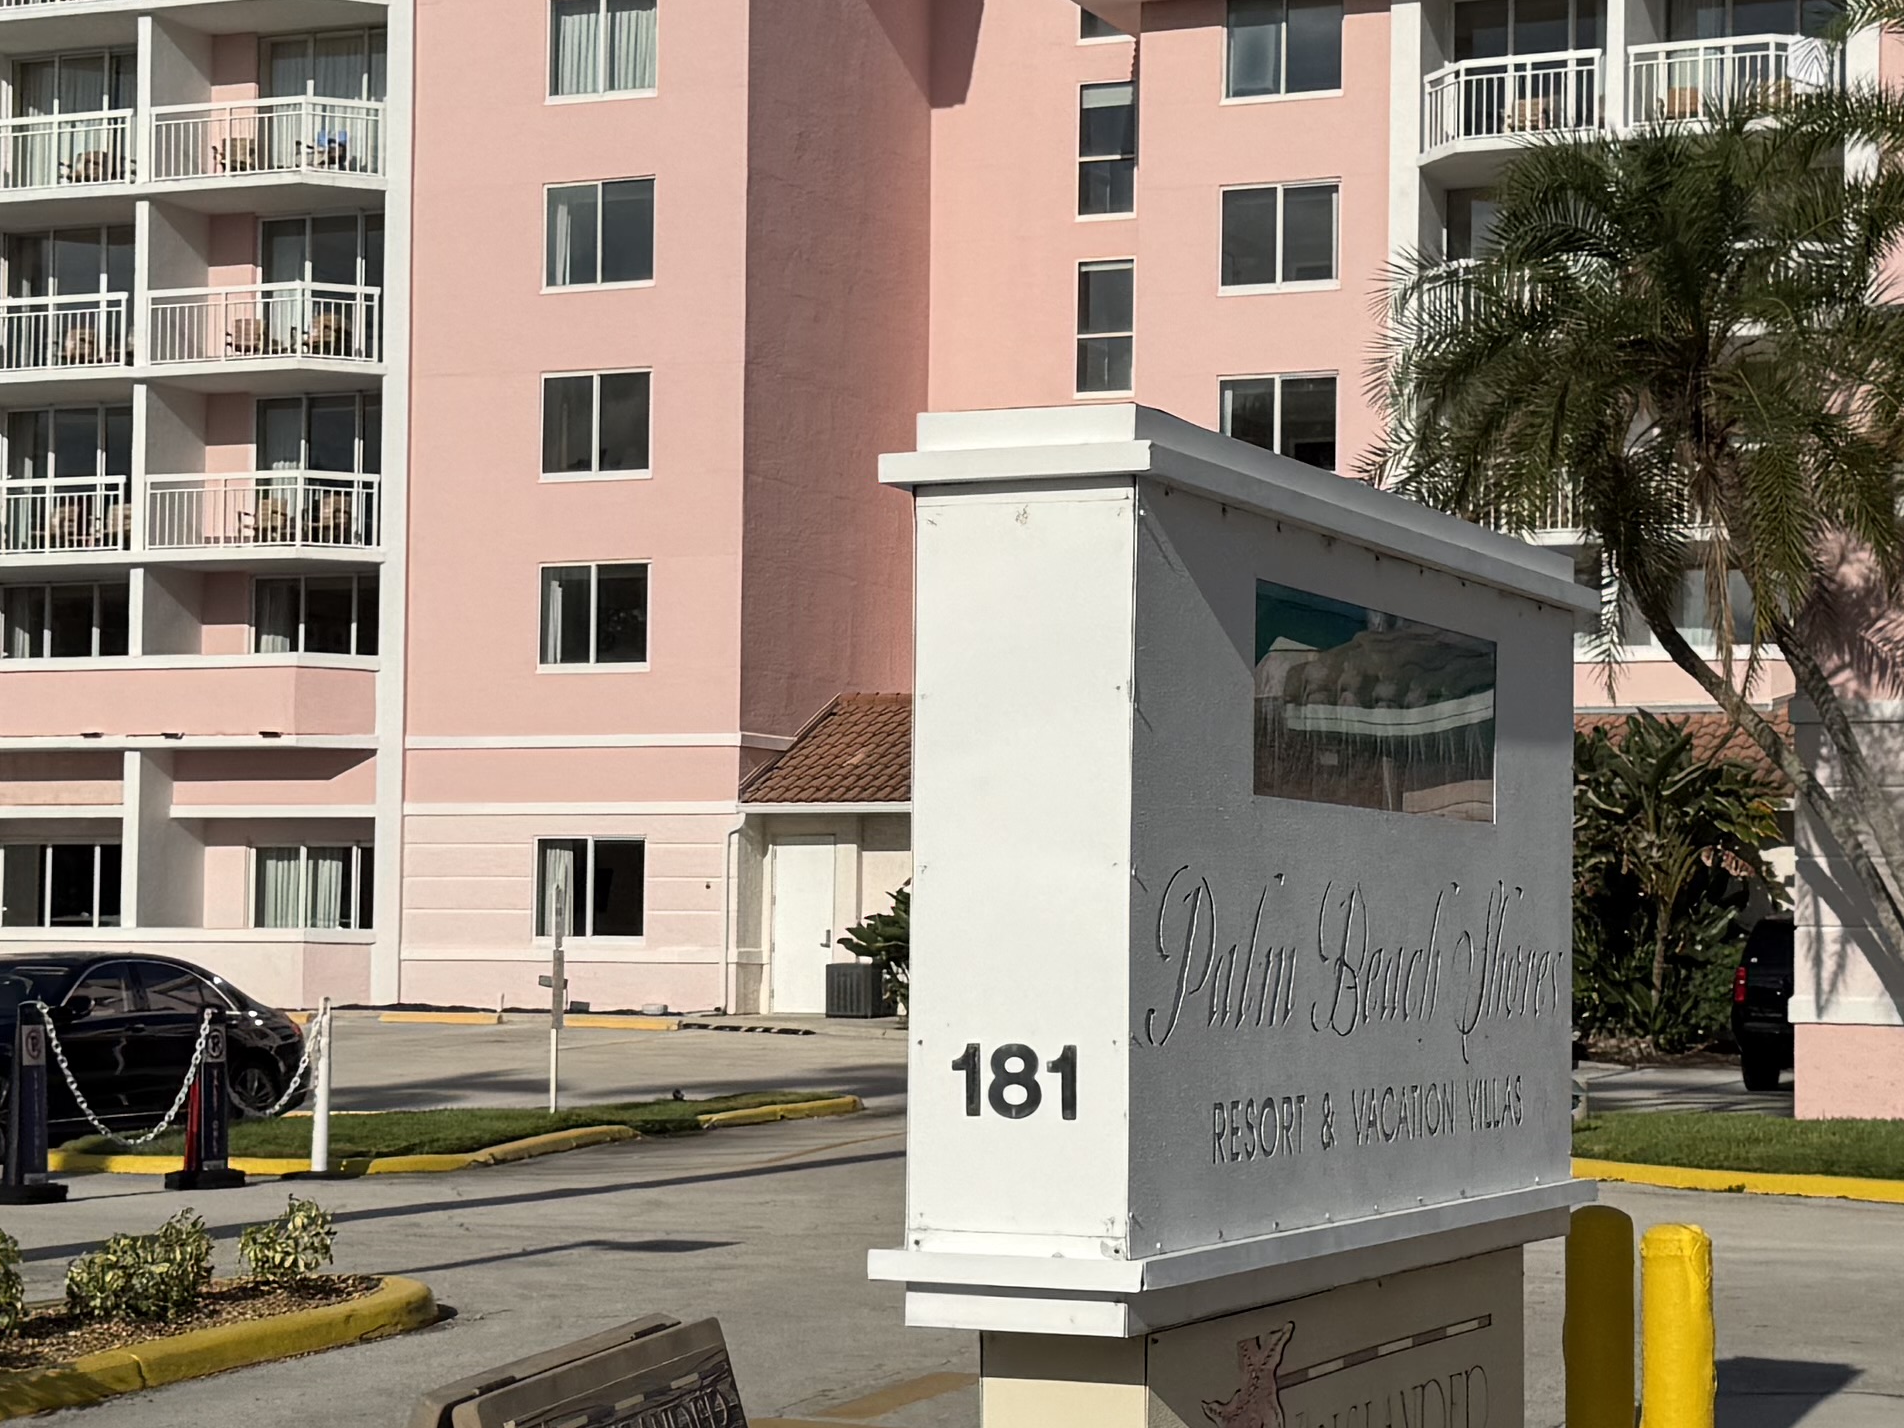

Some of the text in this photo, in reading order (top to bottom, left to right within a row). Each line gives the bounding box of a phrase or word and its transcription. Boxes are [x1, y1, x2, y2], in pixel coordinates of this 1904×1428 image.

[1144, 865, 1564, 1064] Palm Beach Shores
[952, 1042, 1078, 1121] 181
[1212, 1074, 1524, 1164] RESORT & VACATION VILLAS
